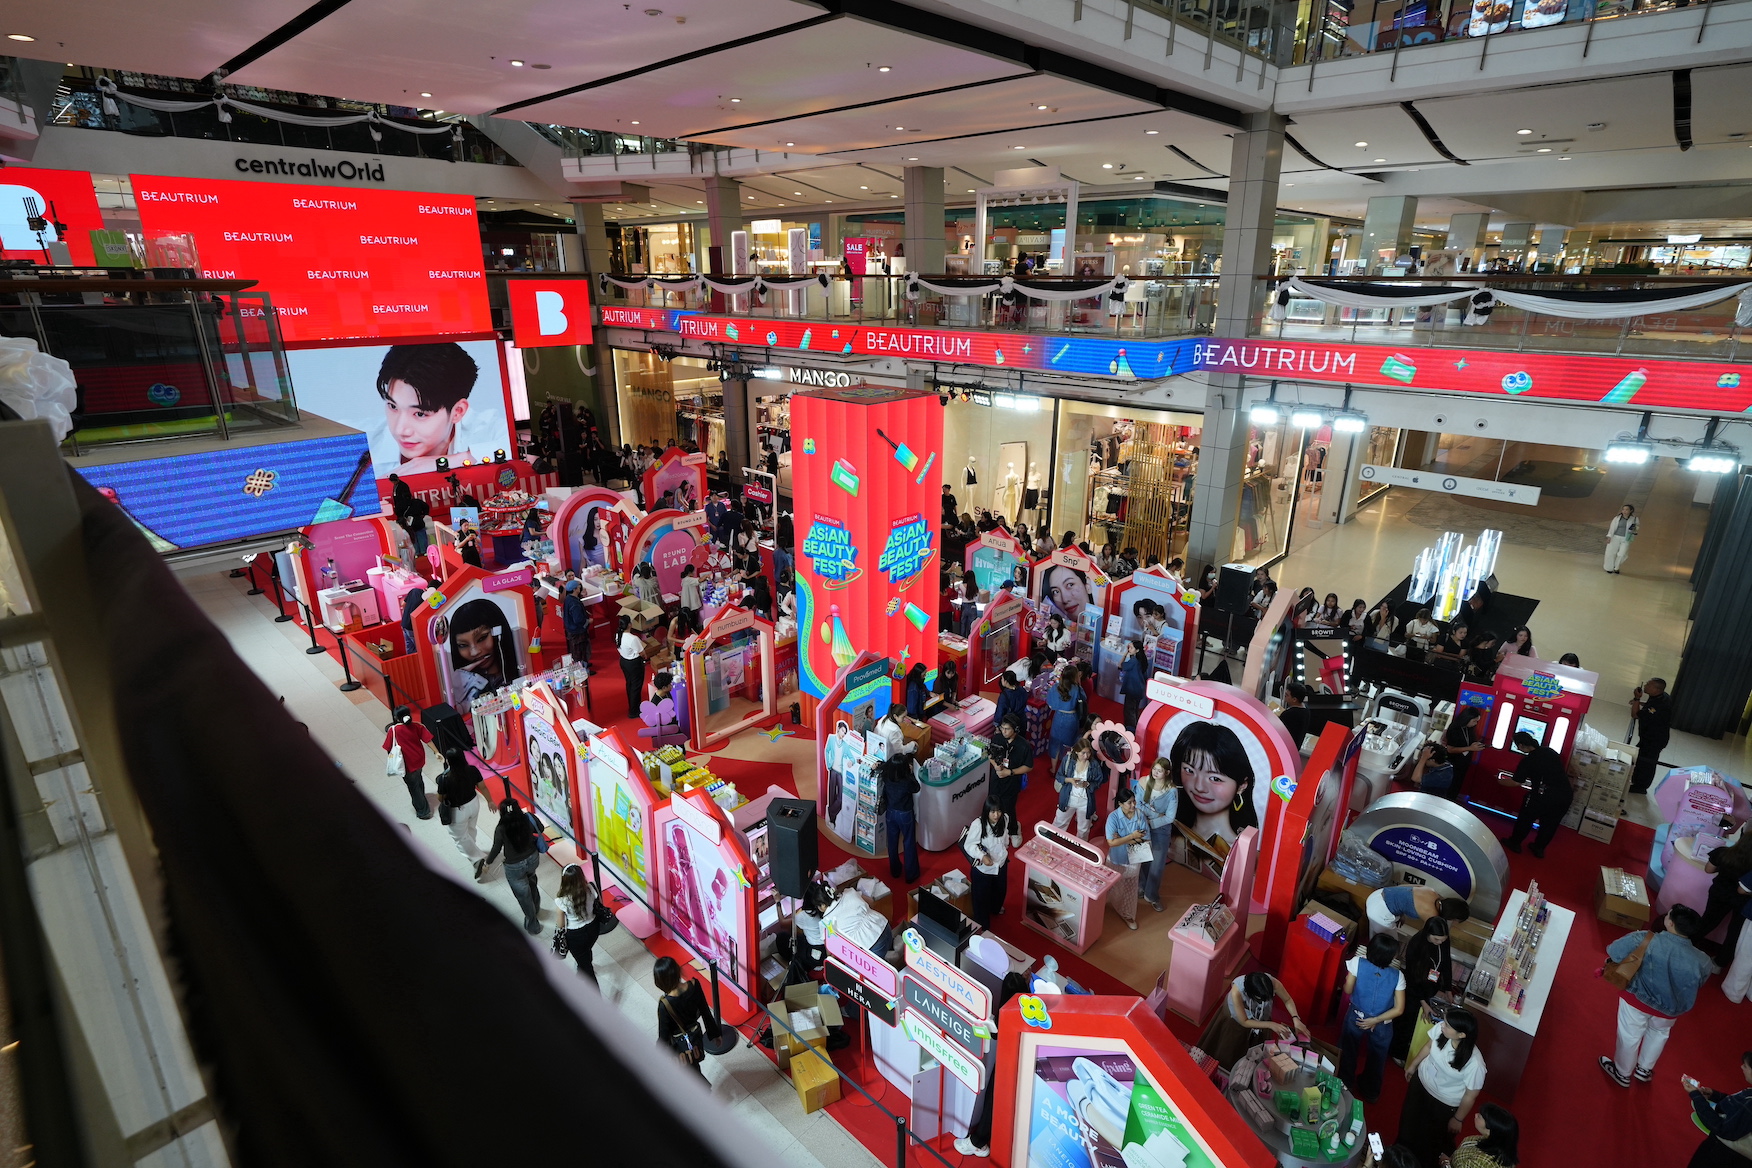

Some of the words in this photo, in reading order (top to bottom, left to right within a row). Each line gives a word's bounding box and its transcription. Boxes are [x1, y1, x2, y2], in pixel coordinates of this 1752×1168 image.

[141, 191, 219, 204] BEAUTRIUM
[293, 198, 357, 210] BEAUTRIUM
[418, 205, 472, 216] BEAUTRIUM
[223, 231, 293, 243] BEAUTRIUM
[360, 235, 418, 245] BEAUTRIUM
[846, 243, 863, 251] SALE
[307, 270, 369, 279] BEAUTRIUM
[428, 270, 481, 279] BEAUTRIUM
[372, 304, 429, 314] BEAUTRIUM
[535, 290, 568, 336] B
[866, 331, 972, 357] BEAUTRIUM
[1192, 343, 1357, 376] BEAUTRIUM
[789, 367, 850, 389] MANGO
[632, 386, 671, 403] MANGO
[747, 488, 768, 499] Cashier
[814, 513, 840, 526] BEAUTRIUM
[892, 514, 918, 527] BEAUTRIUM
[803, 540, 857, 561] BEAUTY
[878, 531, 932, 569] BEAUTY
[663, 555, 687, 569] LAB
[813, 557, 844, 577] FEST
[889, 556, 921, 581] FEST
[492, 579, 502, 587] LA
[1139, 576, 1170, 589] WhiteLab
[717, 616, 748, 631] numbuzin
[1521, 679, 1563, 691] BEAUTY
[1527, 687, 1551, 697] FEST
[1388, 700, 1410, 711] BROWIT
[1398, 840, 1440, 859] MOONBEAM
[1428, 857, 1459, 872] CUSHION
[841, 944, 878, 978] ETUDE
[916, 956, 975, 1005] AESTURA
[847, 987, 872, 1009] HERA
[914, 990, 972, 1044] LANEIGE
[1138, 1102, 1156, 1112] GREEN
[1155, 1106, 1168, 1114] TEA
[1041, 1097, 1053, 1110] A
[1057, 1105, 1099, 1143] MORE
[1141, 1110, 1169, 1122] CERAMIDE
[1040, 1107, 1099, 1154] BEAUTY
